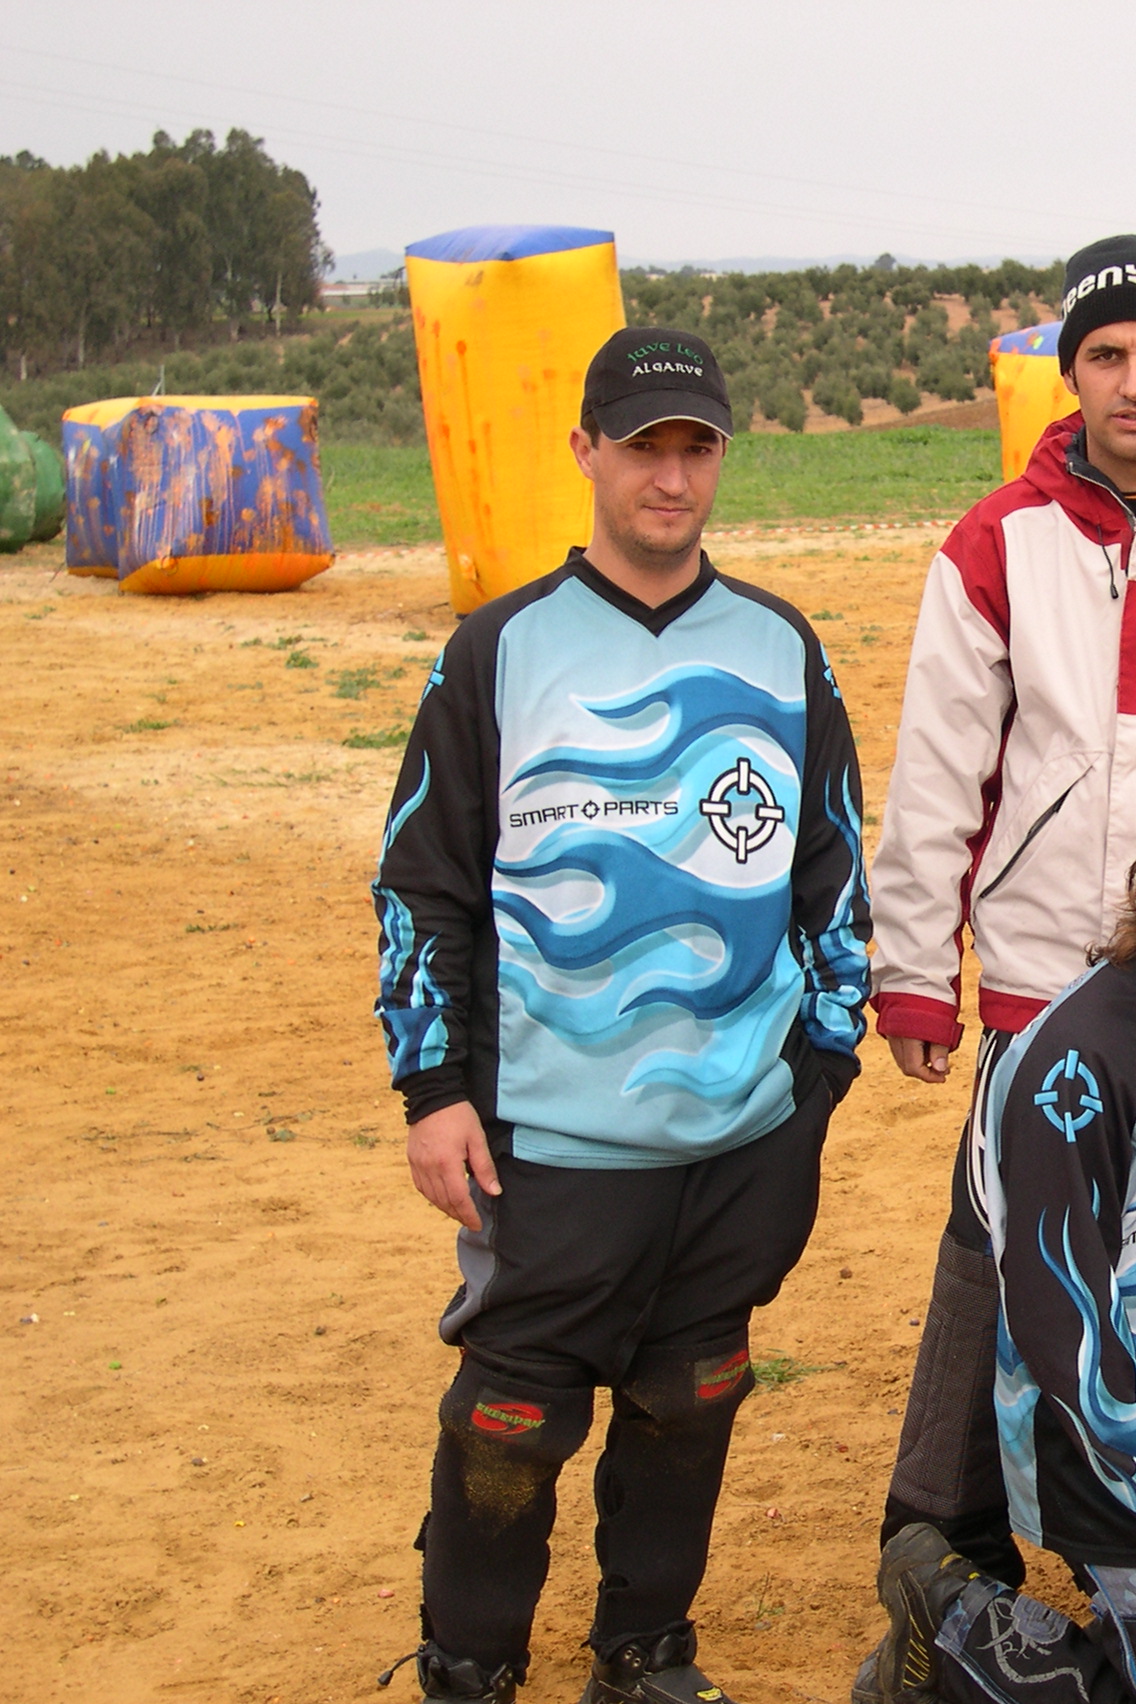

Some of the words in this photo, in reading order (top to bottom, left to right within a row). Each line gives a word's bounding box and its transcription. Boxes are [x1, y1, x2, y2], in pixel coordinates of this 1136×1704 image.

[632, 362, 704, 377] ALGARVE
[510, 804, 579, 828] SMART
[604, 801, 679, 816] PARTS
